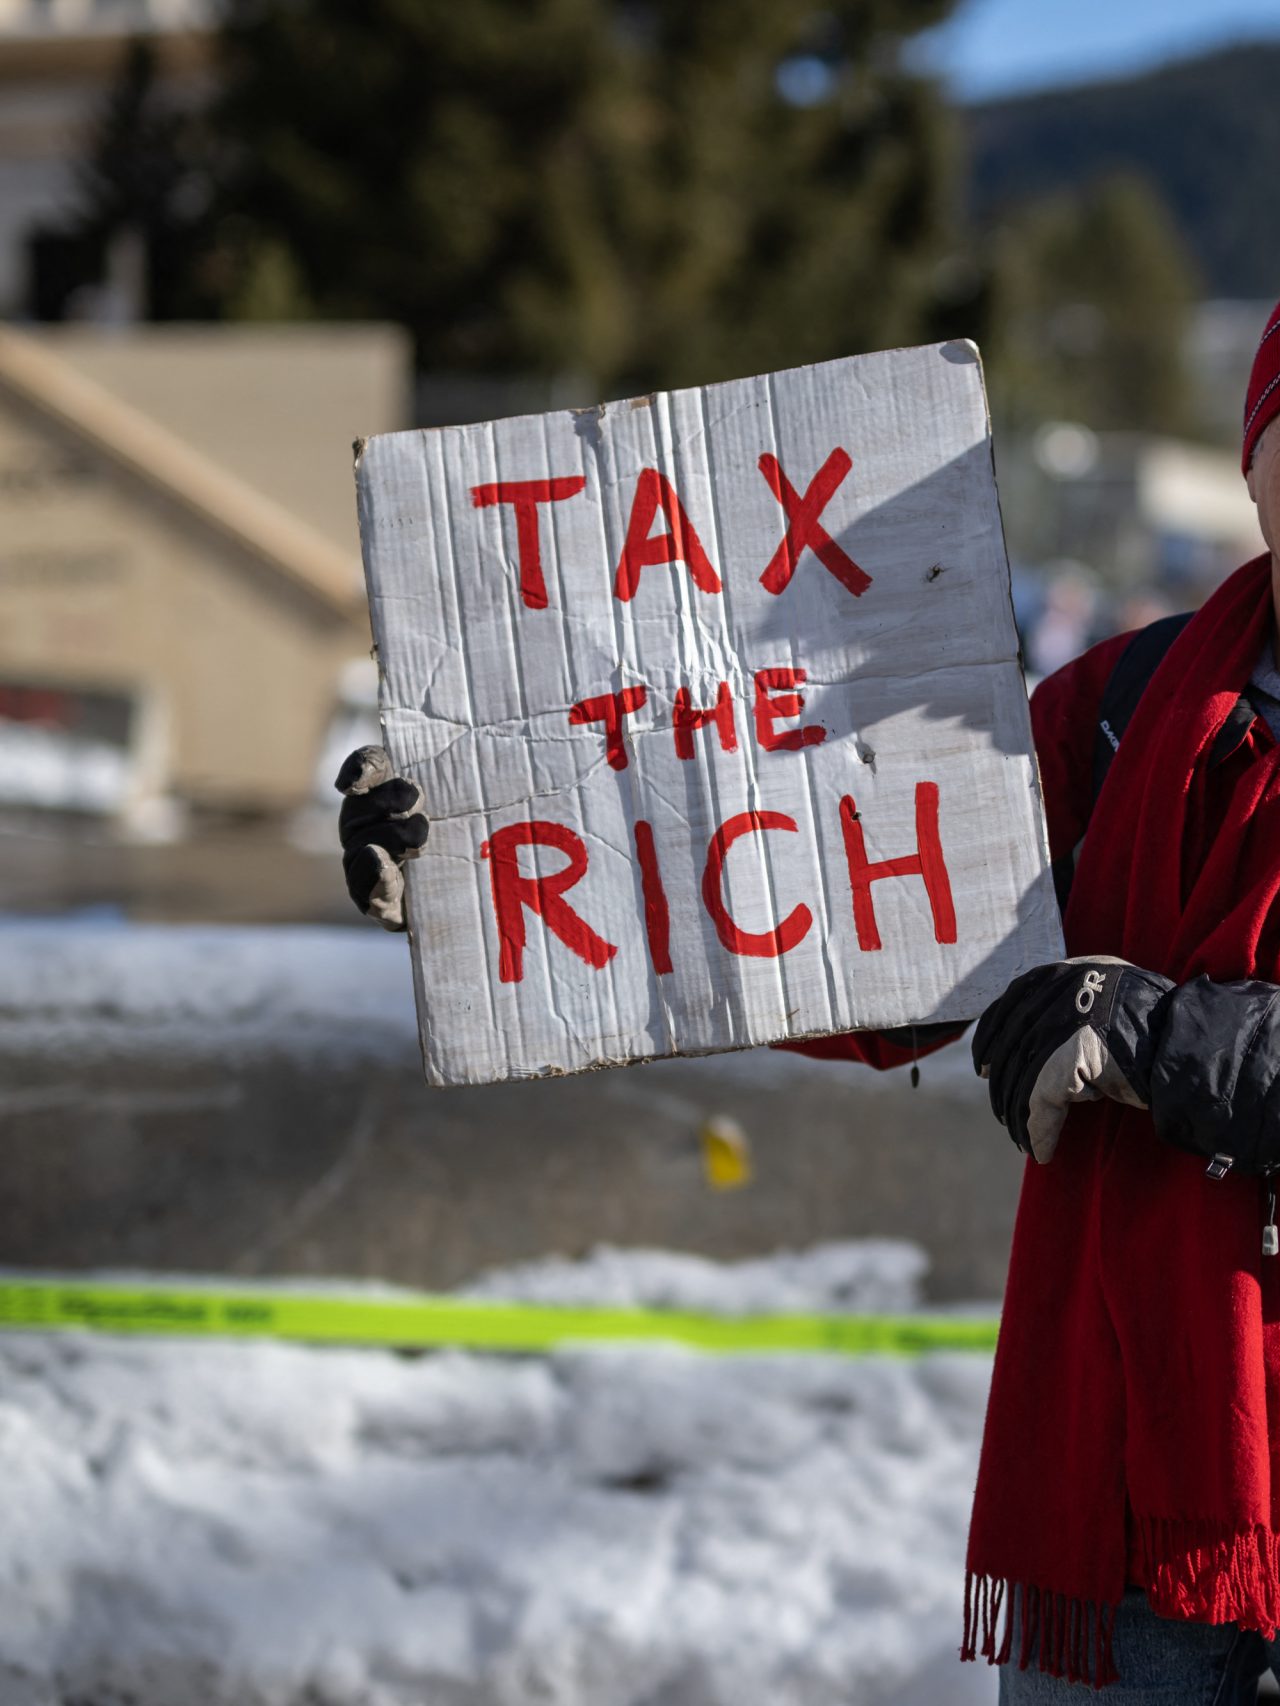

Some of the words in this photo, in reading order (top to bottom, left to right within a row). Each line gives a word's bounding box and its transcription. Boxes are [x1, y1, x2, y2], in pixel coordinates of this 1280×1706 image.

[471, 447, 872, 610] TAX
[568, 667, 827, 772] THE
[480, 781, 958, 983] RICH
[1075, 970, 1107, 1014] OR
